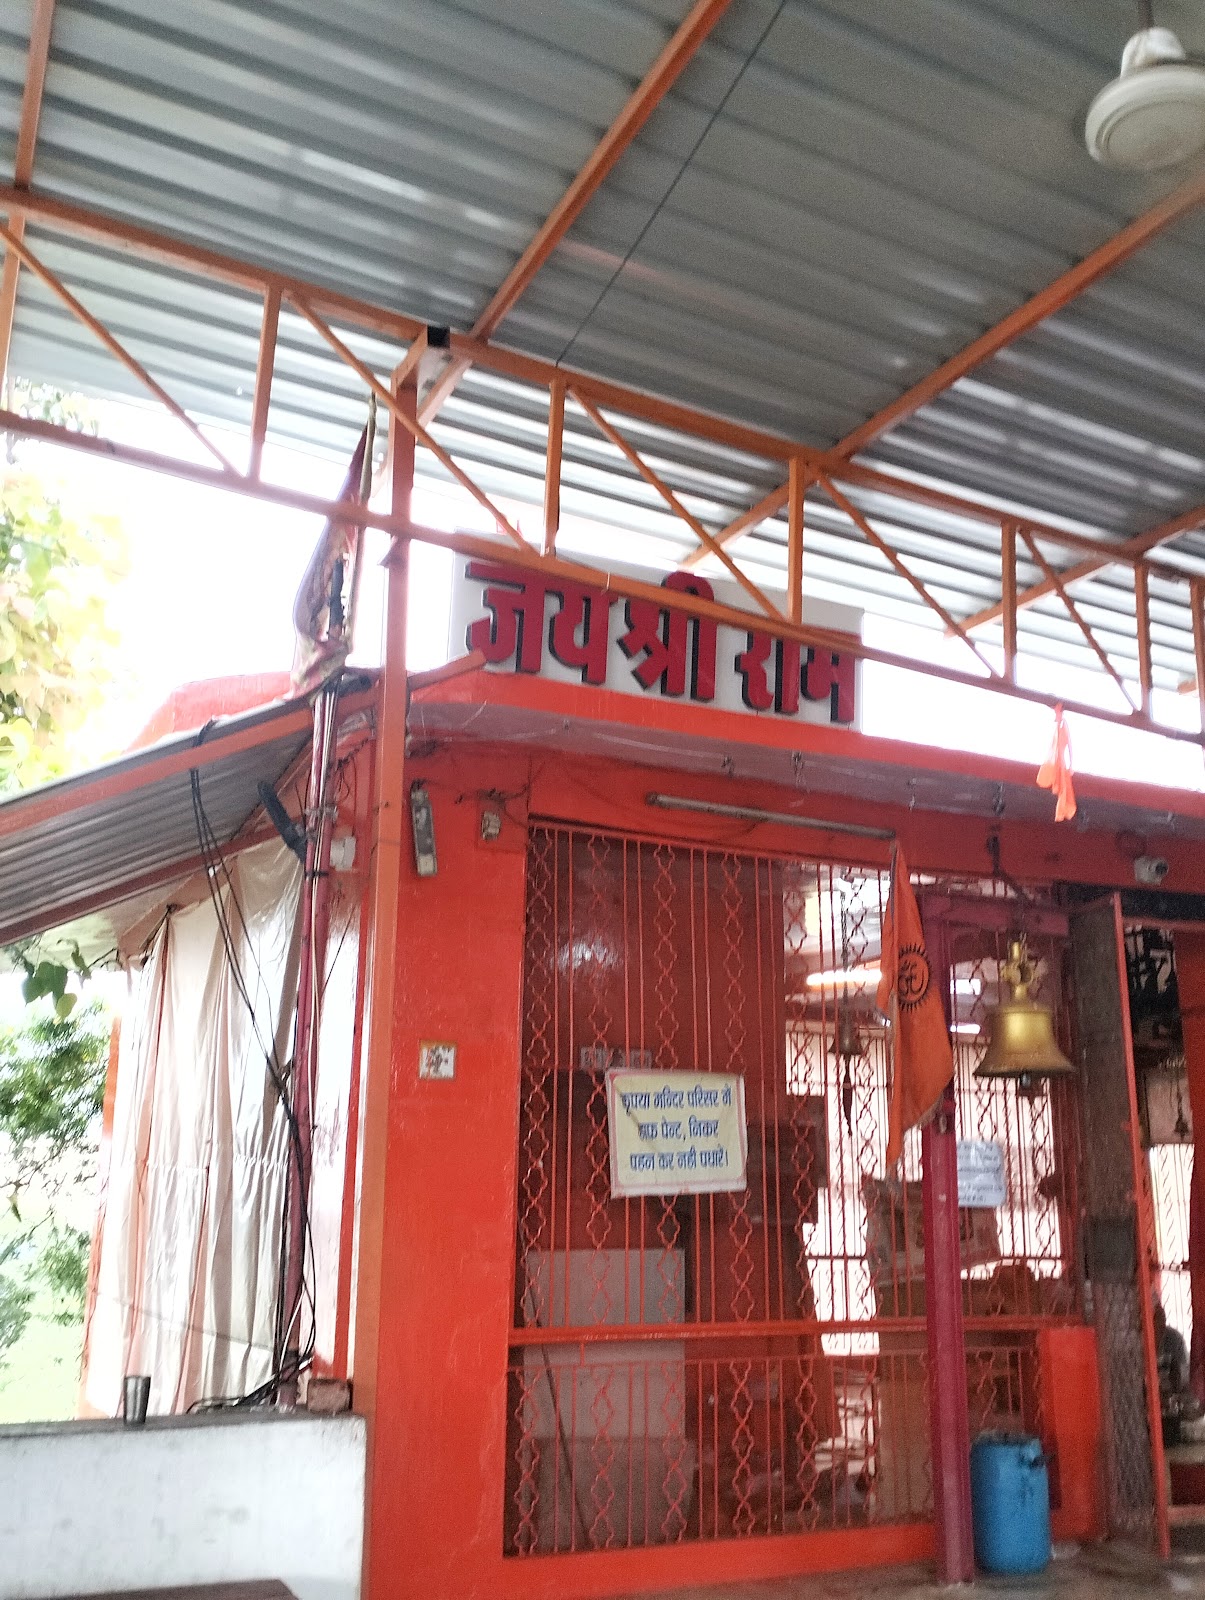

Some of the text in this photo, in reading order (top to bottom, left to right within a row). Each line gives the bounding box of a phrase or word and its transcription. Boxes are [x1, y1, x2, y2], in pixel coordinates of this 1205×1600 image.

[465, 561, 861, 723] जय श्री राम
[621, 1091, 650, 1116] कृपया
[653, 1084, 684, 1109] मन्दिर
[687, 1083, 719, 1108] परिसर
[688, 1114, 719, 1138] निकर
[630, 1152, 655, 1172] पहन
[658, 1152, 674, 1171] कर
